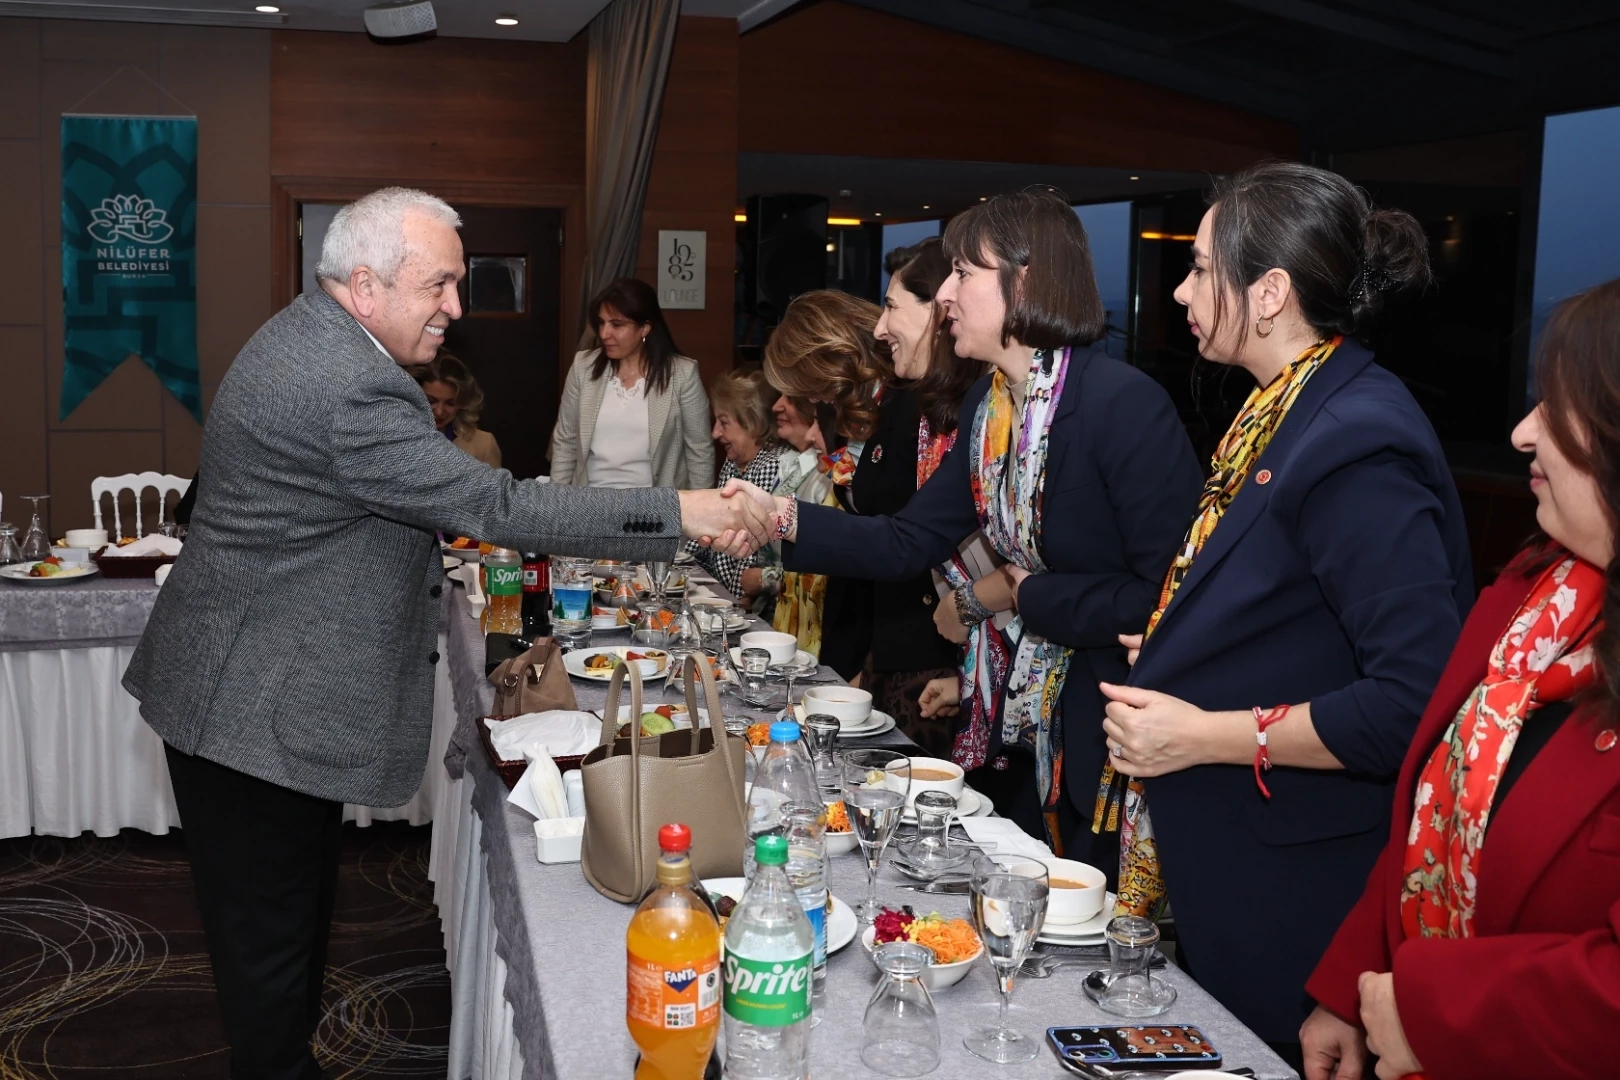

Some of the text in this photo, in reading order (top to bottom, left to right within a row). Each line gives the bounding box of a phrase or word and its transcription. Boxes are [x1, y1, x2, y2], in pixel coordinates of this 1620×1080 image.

[97, 245, 170, 259] NİLÜFER
[98, 261, 169, 271] BELEDİYESİ
[494, 567, 523, 586] Spri
[664, 968, 697, 983] FANTA
[724, 955, 808, 996] Sprite
